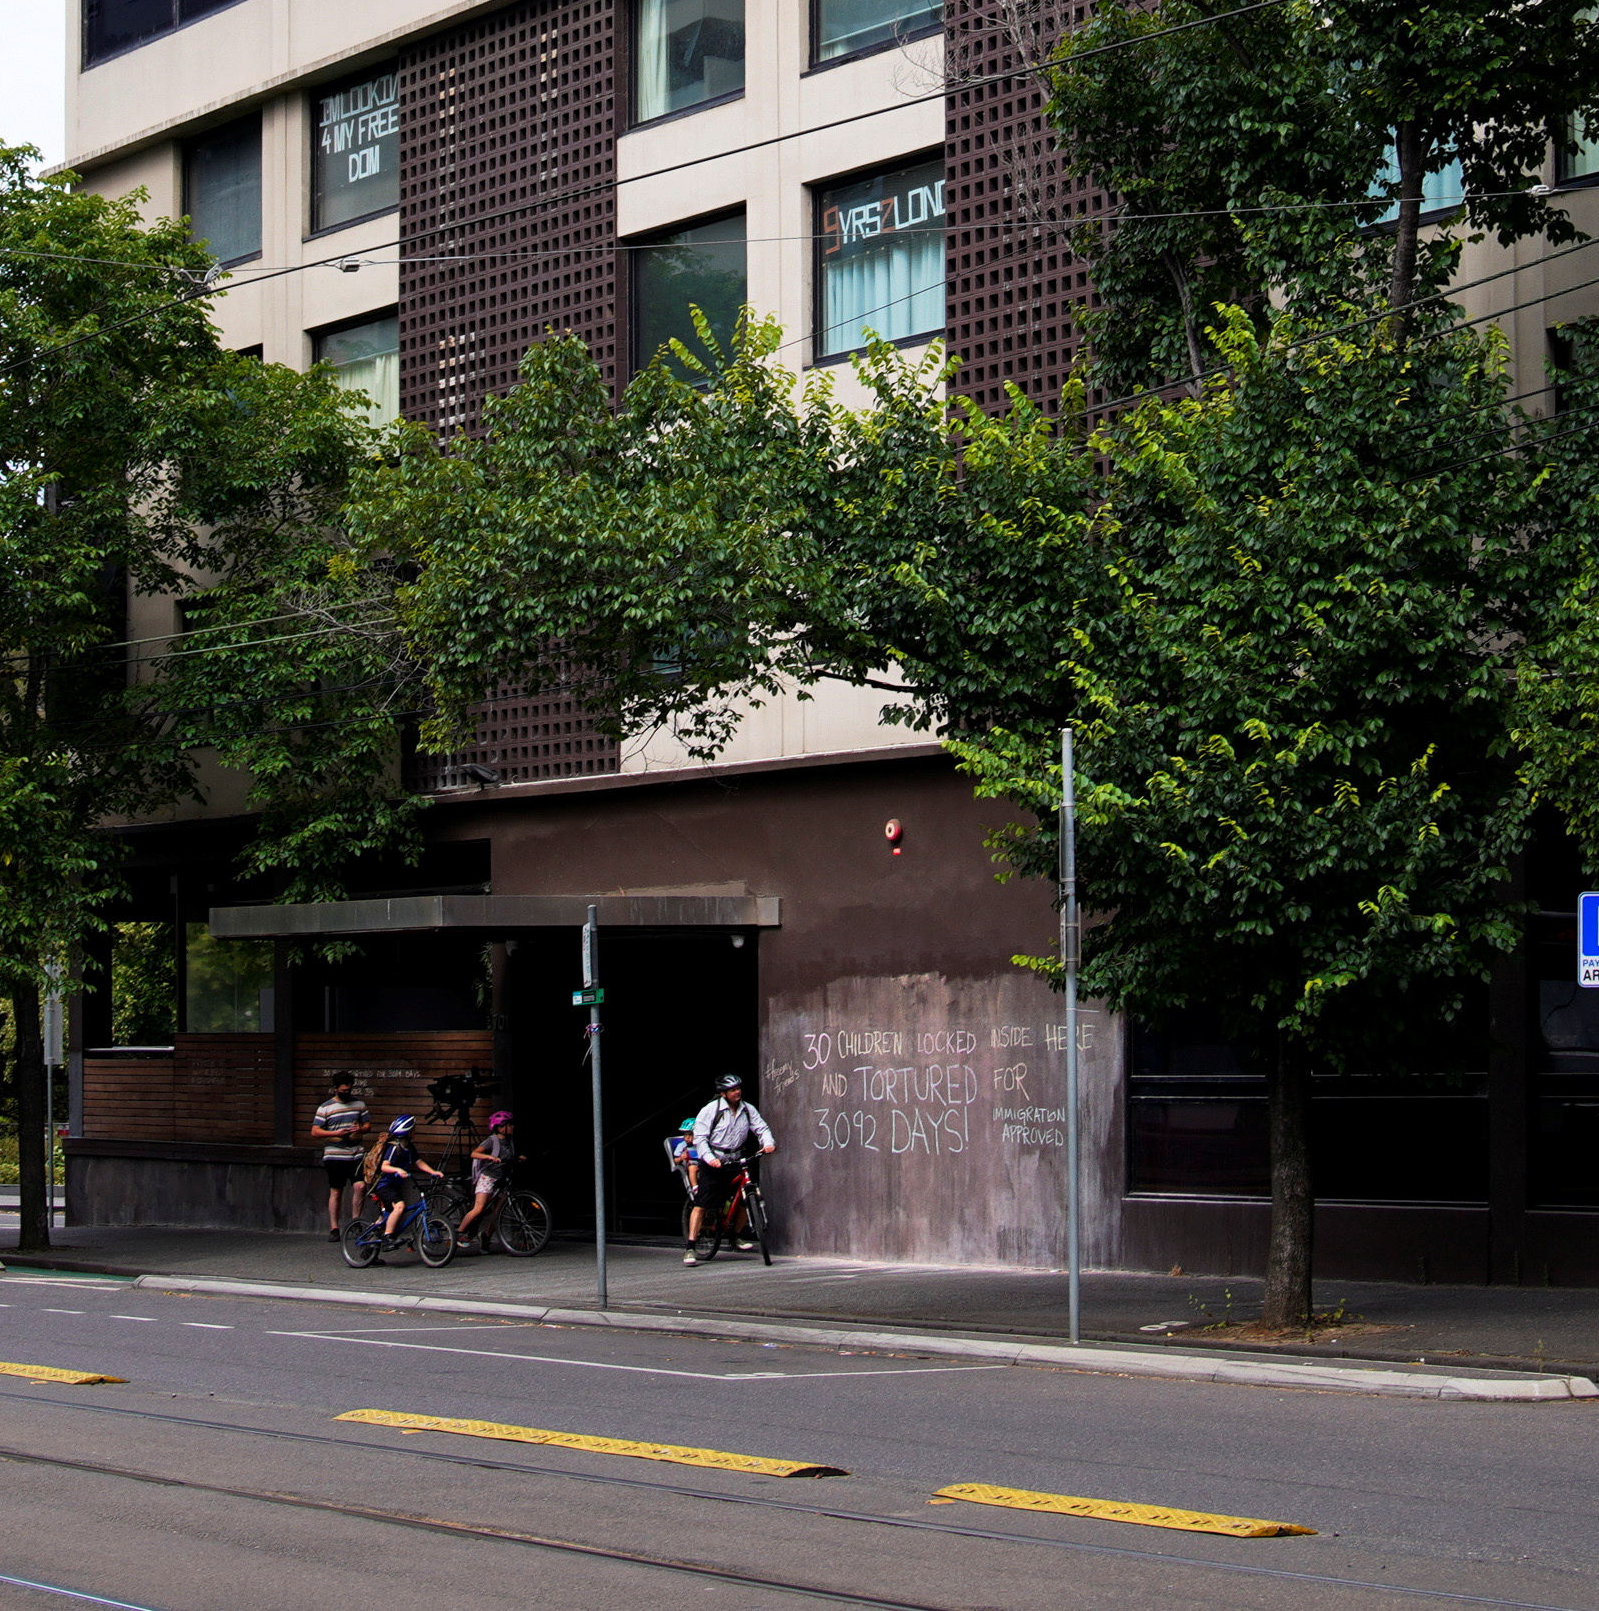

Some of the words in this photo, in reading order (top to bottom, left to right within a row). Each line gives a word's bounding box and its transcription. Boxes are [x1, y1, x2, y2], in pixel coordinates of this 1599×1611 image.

[334, 119, 354, 154] MY
[358, 103, 399, 145] FREE
[348, 144, 380, 182] DOM
[803, 1033, 831, 1070] 30
[838, 1030, 902, 1058] CHILDREN
[918, 1031, 976, 1054] LOCKED
[990, 1026, 1034, 1048] INSIDE
[822, 1072, 848, 1098] AND
[854, 1064, 978, 1106] TORTURED
[994, 1062, 1030, 1101] FOR
[814, 1108, 880, 1152] 3,092
[891, 1106, 969, 1156] DAYS!
[1002, 1123, 1064, 1146] APPROVED
